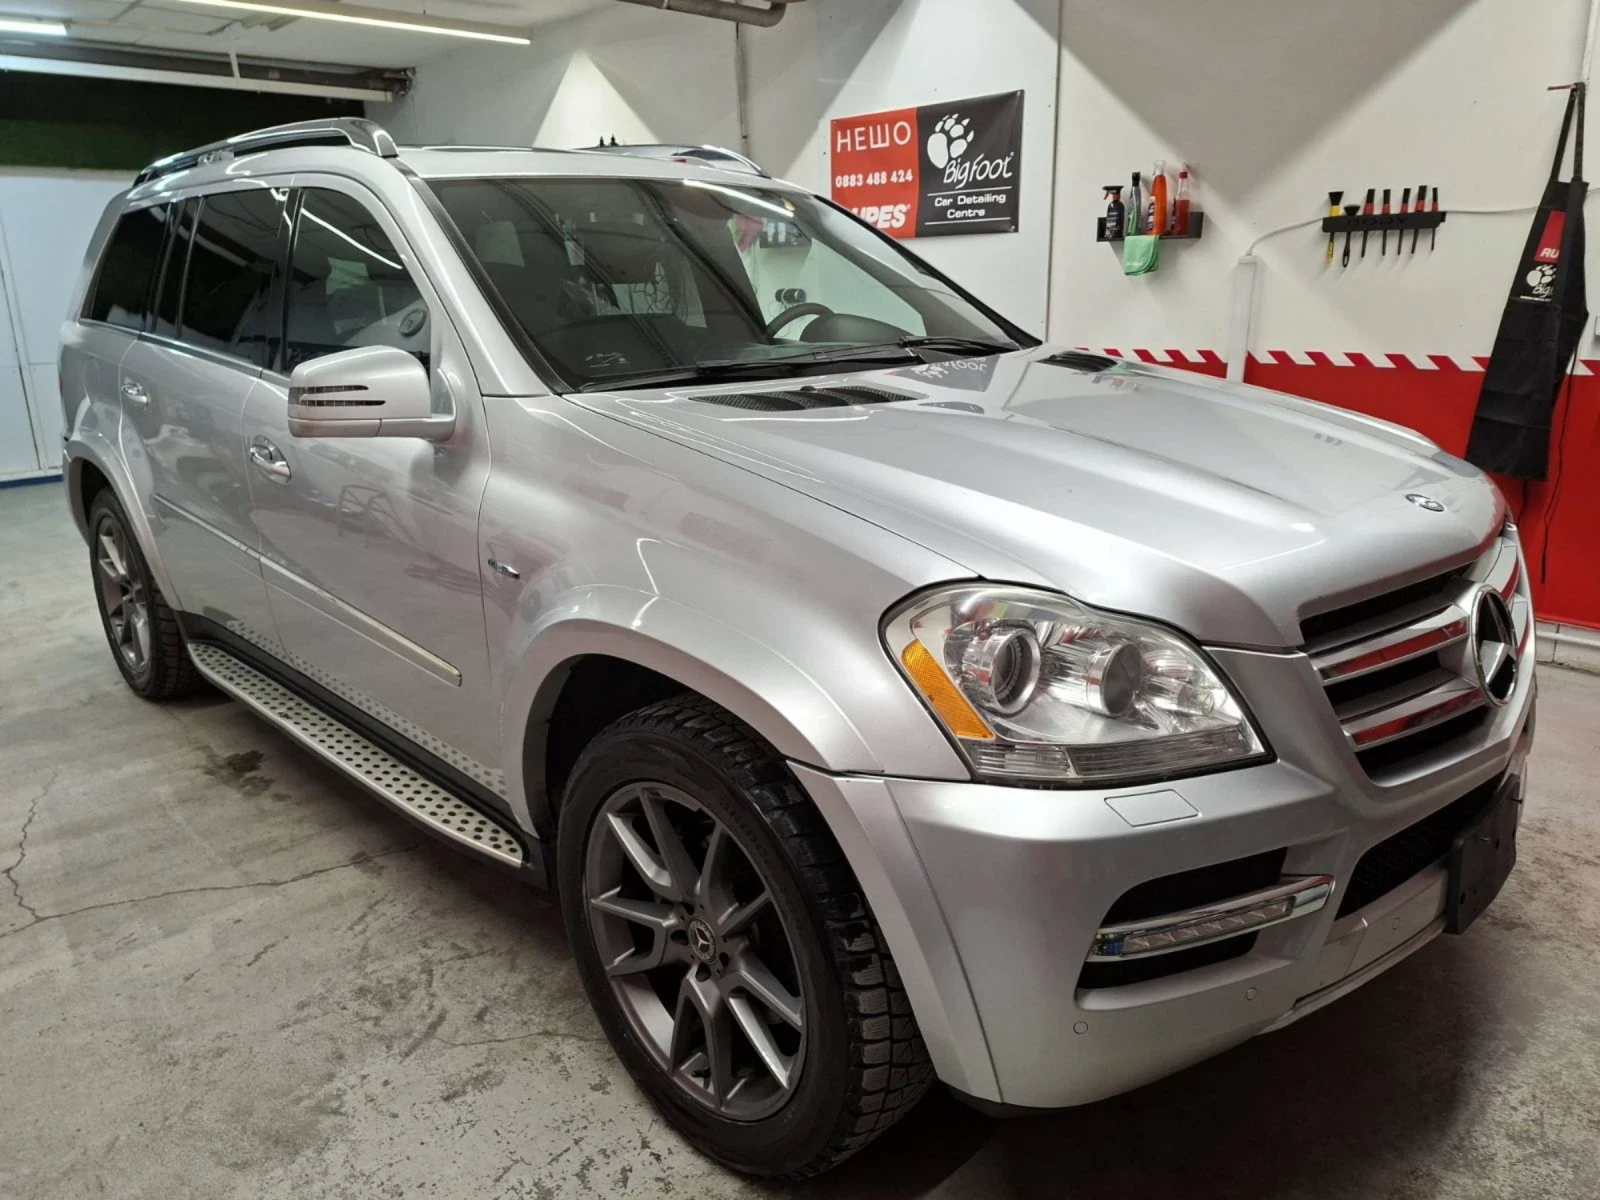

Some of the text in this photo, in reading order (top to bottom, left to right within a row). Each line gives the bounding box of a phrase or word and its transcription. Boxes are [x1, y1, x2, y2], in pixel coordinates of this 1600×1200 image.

[837, 121, 911, 153] НЕШО
[835, 168, 913, 188] 0883 488 424
[934, 193, 1006, 207] Car Detailing
[947, 208, 985, 219] Centre
